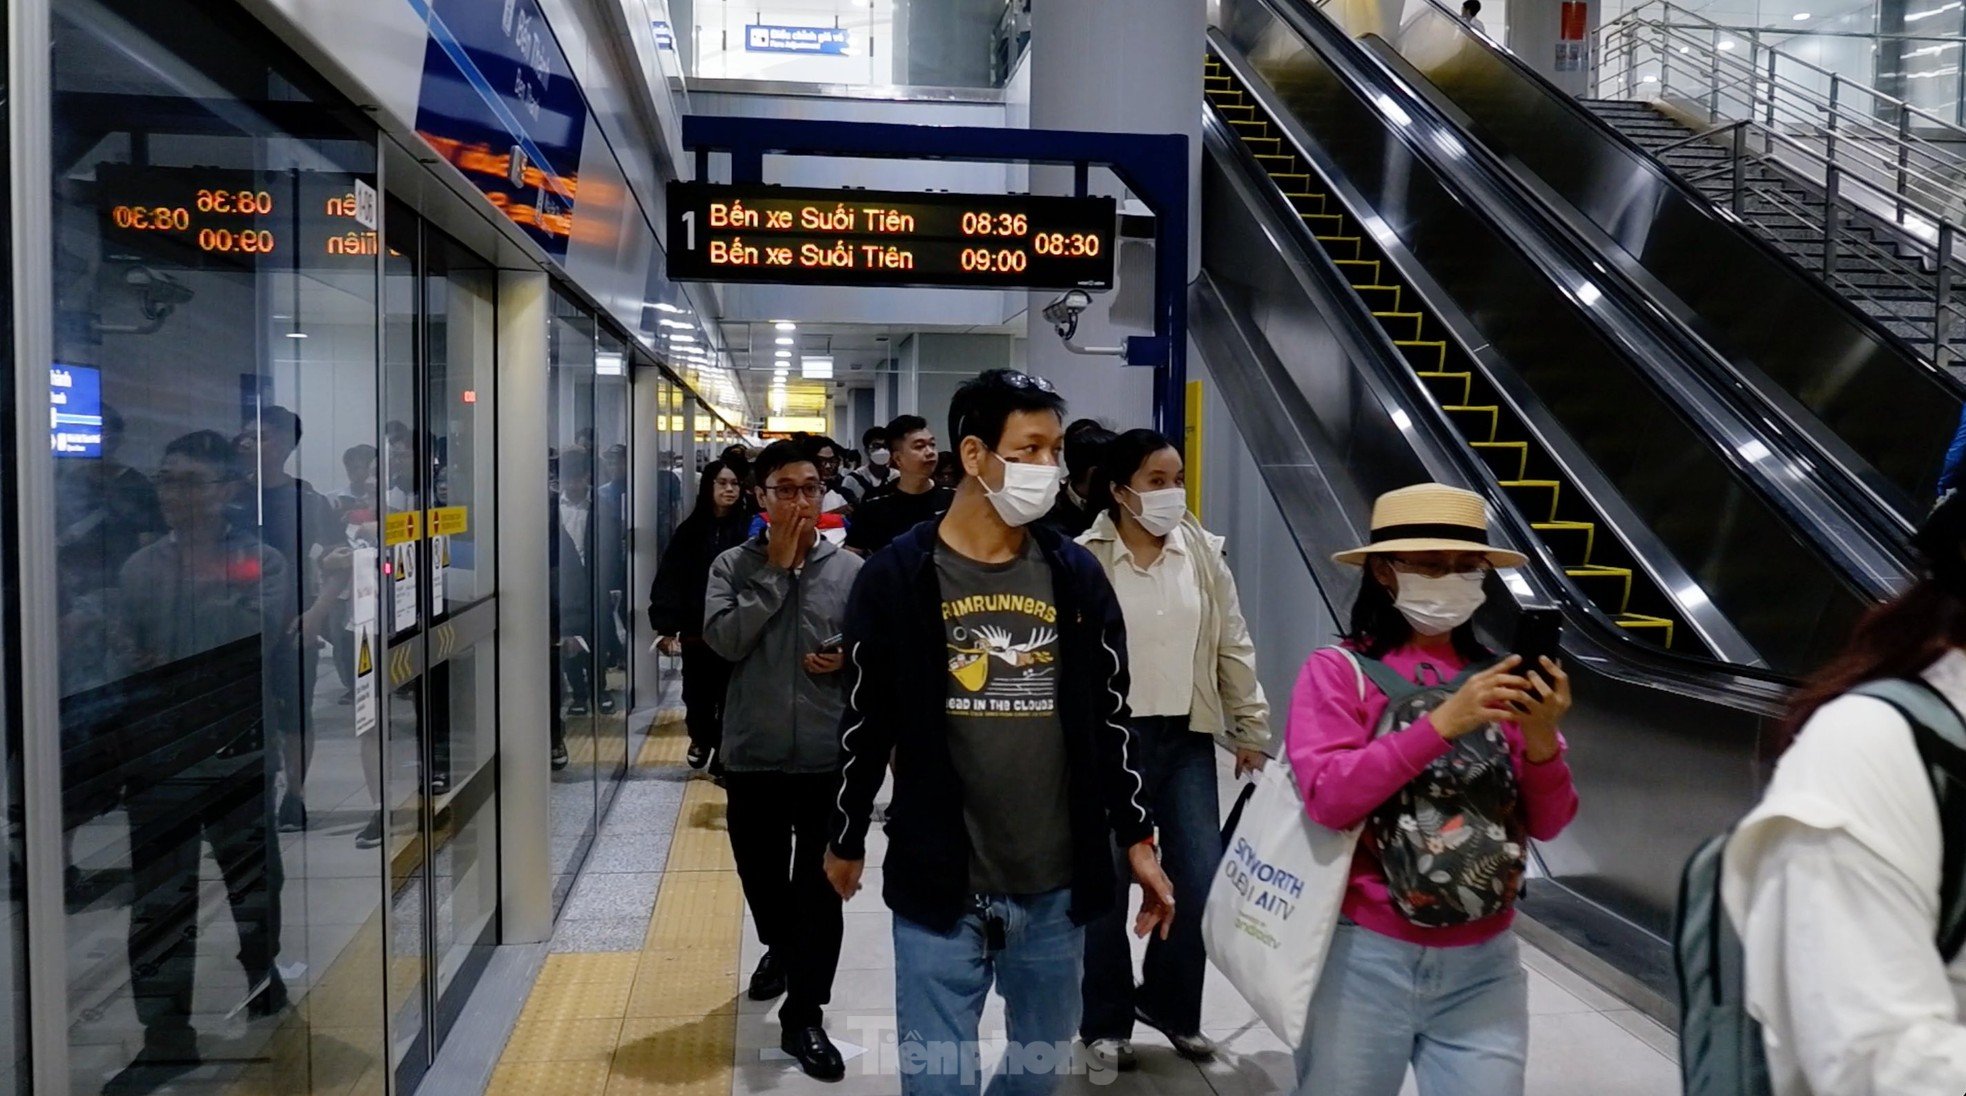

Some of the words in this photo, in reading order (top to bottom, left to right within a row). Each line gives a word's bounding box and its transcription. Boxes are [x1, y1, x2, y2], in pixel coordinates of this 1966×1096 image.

[682, 211, 695, 250] 1
[710, 200, 759, 228] Bến
[765, 210, 793, 229] xe
[800, 203, 854, 231] Suối
[863, 208, 914, 233] Tiên
[962, 212, 1028, 236] 08:36
[710, 237, 759, 265] Bến
[765, 247, 793, 266] xe
[800, 240, 854, 268] Suối
[862, 246, 913, 270] Tiên
[961, 249, 1027, 272] 09:00
[1034, 233, 1099, 257] 08:30
